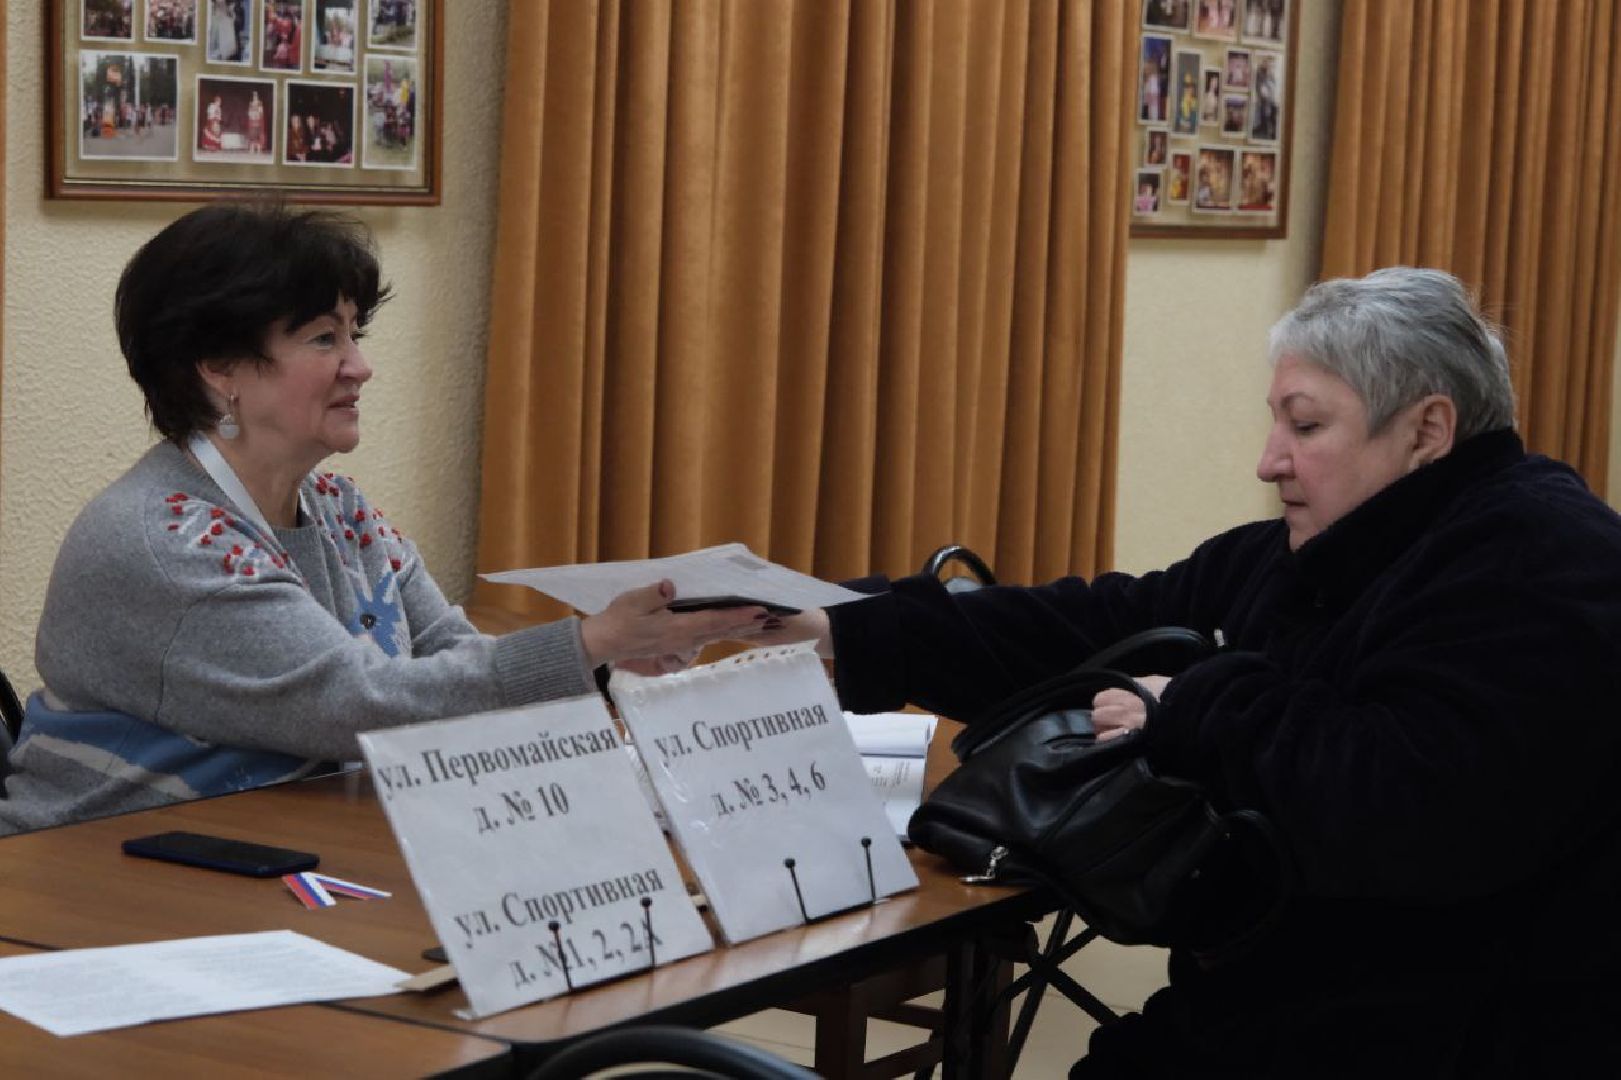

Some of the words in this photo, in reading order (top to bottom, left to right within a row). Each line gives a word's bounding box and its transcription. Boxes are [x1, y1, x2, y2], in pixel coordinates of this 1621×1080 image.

[377, 764, 421, 800] ул.
[422, 729, 619, 786] Первомайская
[654, 735, 692, 768] ул.
[692, 704, 829, 752] Спортивная
[472, 806, 500, 834] д.
[537, 782, 570, 817] 10
[711, 793, 735, 816] д.
[762, 773, 788, 805] 3,
[788, 767, 811, 800] 4,
[810, 761, 826, 791] 6
[454, 911, 500, 949] ул.
[502, 869, 664, 926] Спортивная
[510, 960, 536, 990] д.
[592, 929, 625, 963] 2,
